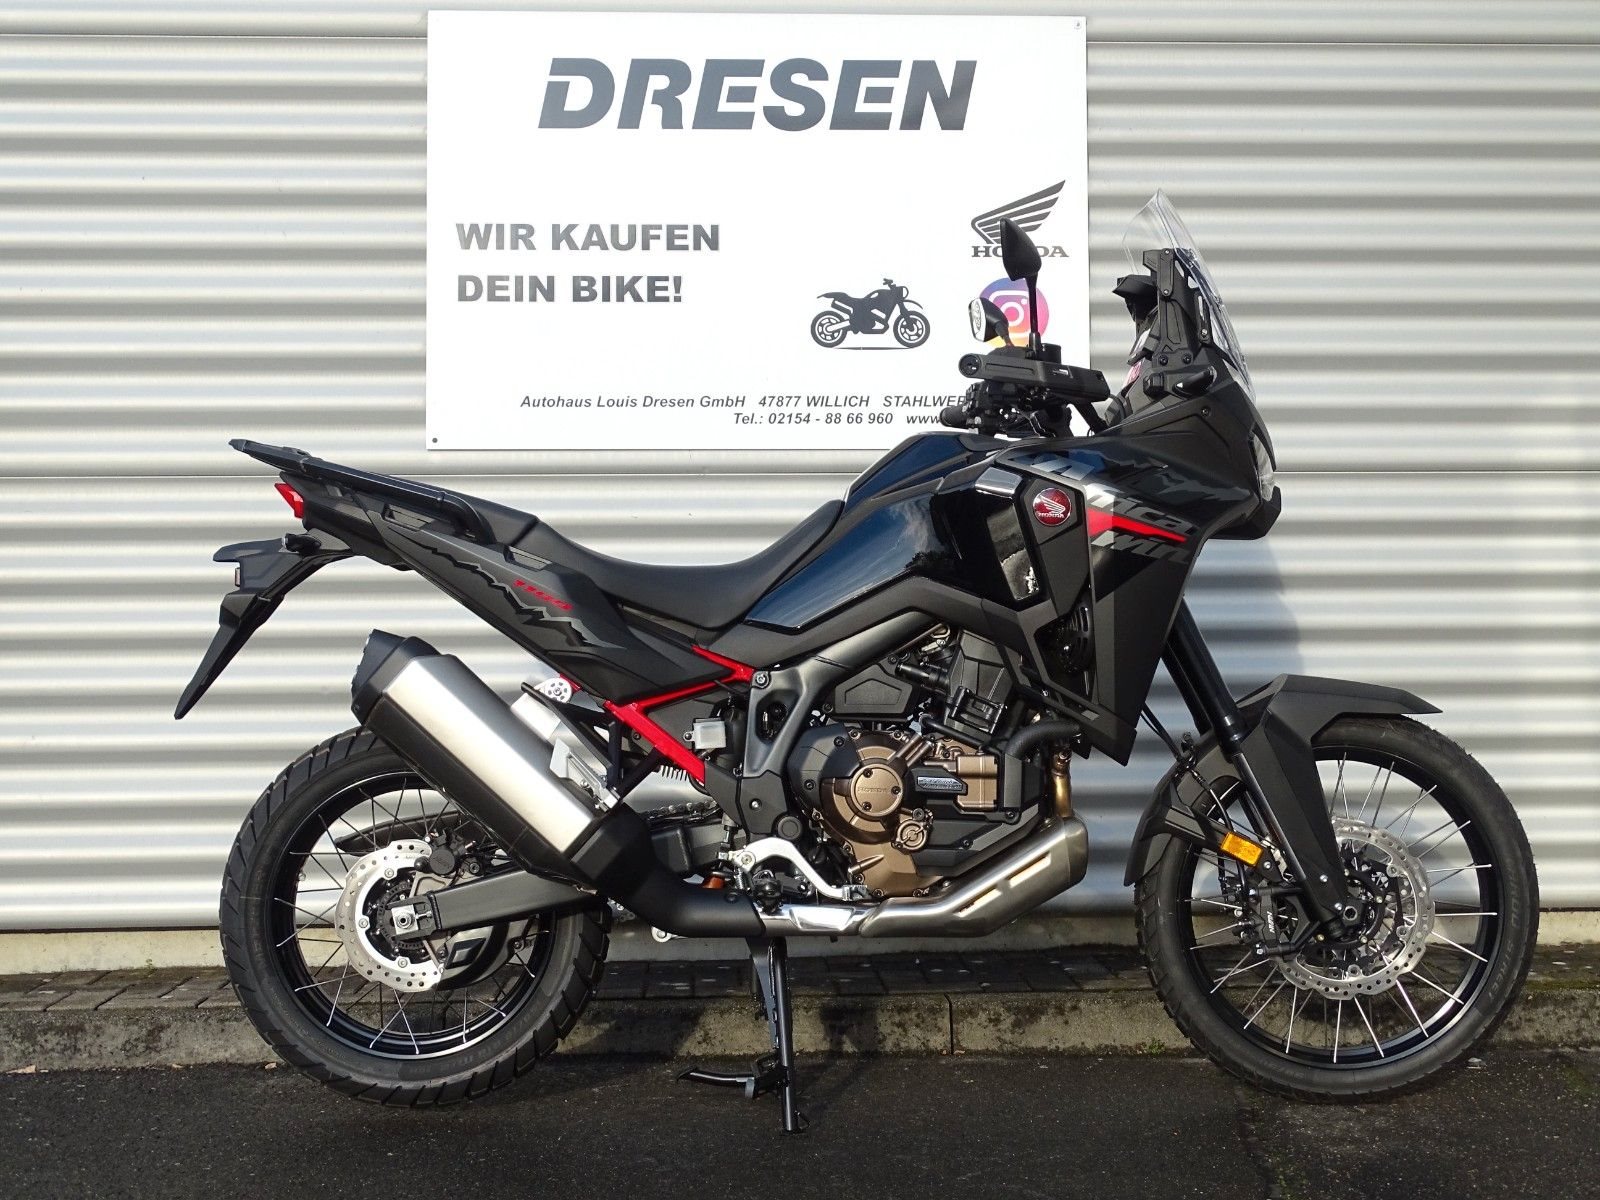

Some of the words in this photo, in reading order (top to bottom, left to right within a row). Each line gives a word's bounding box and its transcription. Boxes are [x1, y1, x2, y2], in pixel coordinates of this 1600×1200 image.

[538, 58, 977, 131] DRESEN
[455, 224, 535, 250] WIR
[552, 224, 719, 251] KAUFEN
[457, 275, 555, 302] DEIN
[572, 275, 682, 303] BIKE!
[520, 395, 592, 408] Autohaus
[596, 395, 638, 408] Louis
[642, 395, 695, 408] Dresen
[700, 395, 746, 408] GmbH
[758, 395, 802, 408] 47877
[806, 395, 870, 408] WILLICH
[734, 412, 763, 425] Tel.:
[768, 412, 811, 425] 02154
[824, 412, 842, 425] 88
[846, 412, 863, 425] 66
[868, 412, 894, 425] 960
